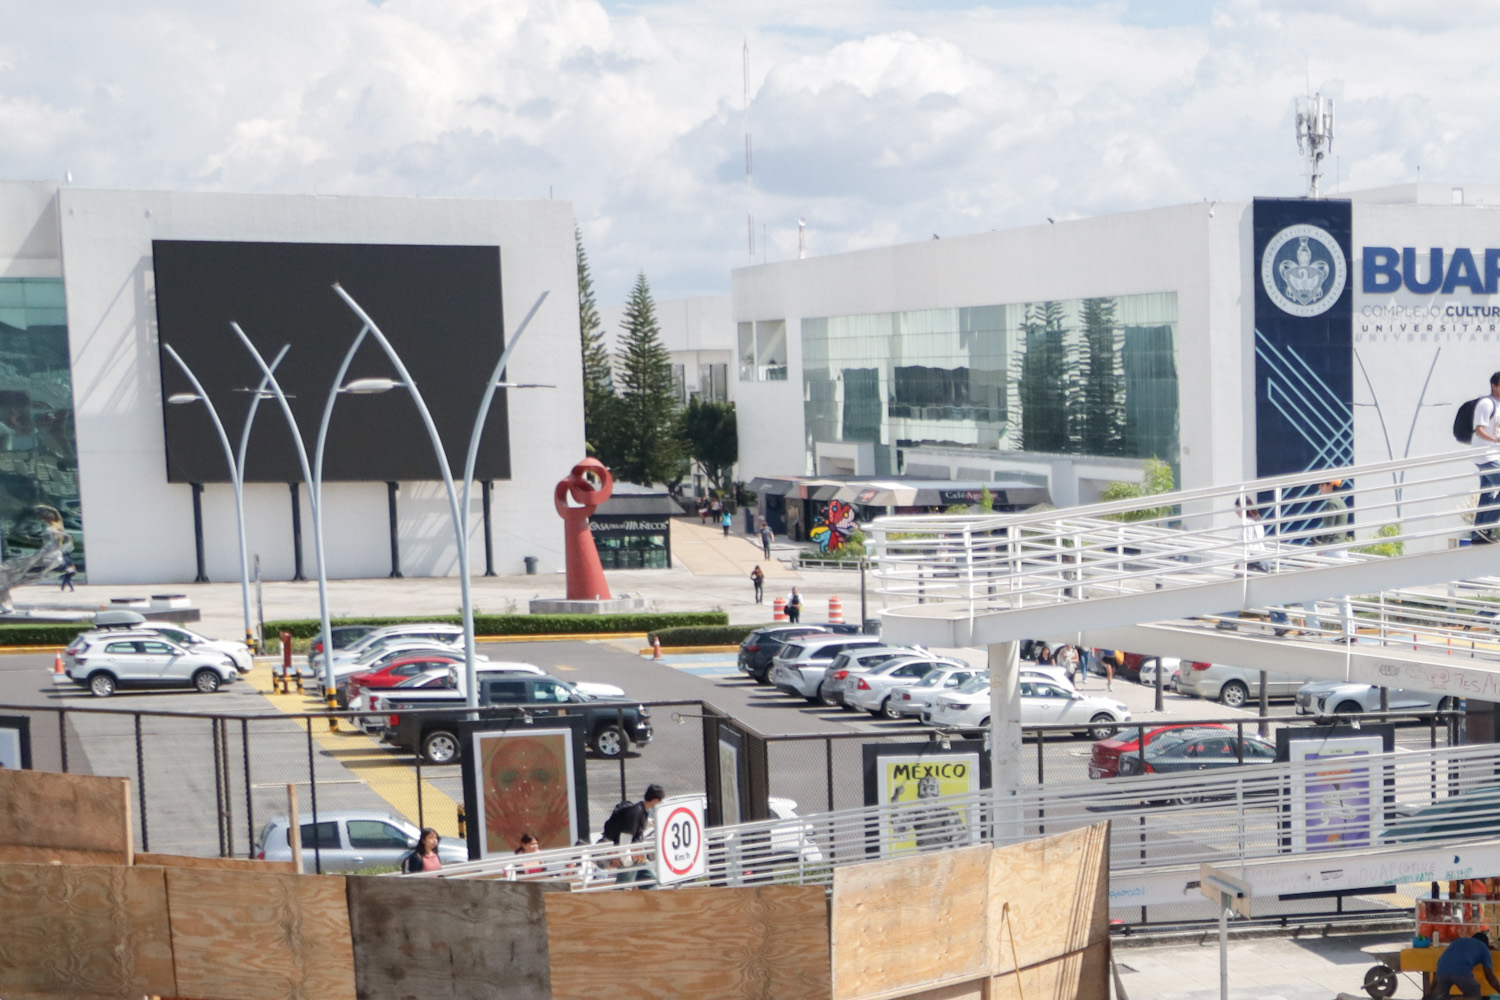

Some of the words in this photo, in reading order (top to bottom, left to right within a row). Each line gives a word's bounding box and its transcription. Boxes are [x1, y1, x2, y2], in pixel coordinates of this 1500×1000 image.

[1362, 305, 1441, 318] COMPLEJO
[893, 762, 966, 781] MÉXICO
[671, 821, 692, 850] 30
[674, 853, 691, 863] Km/h
